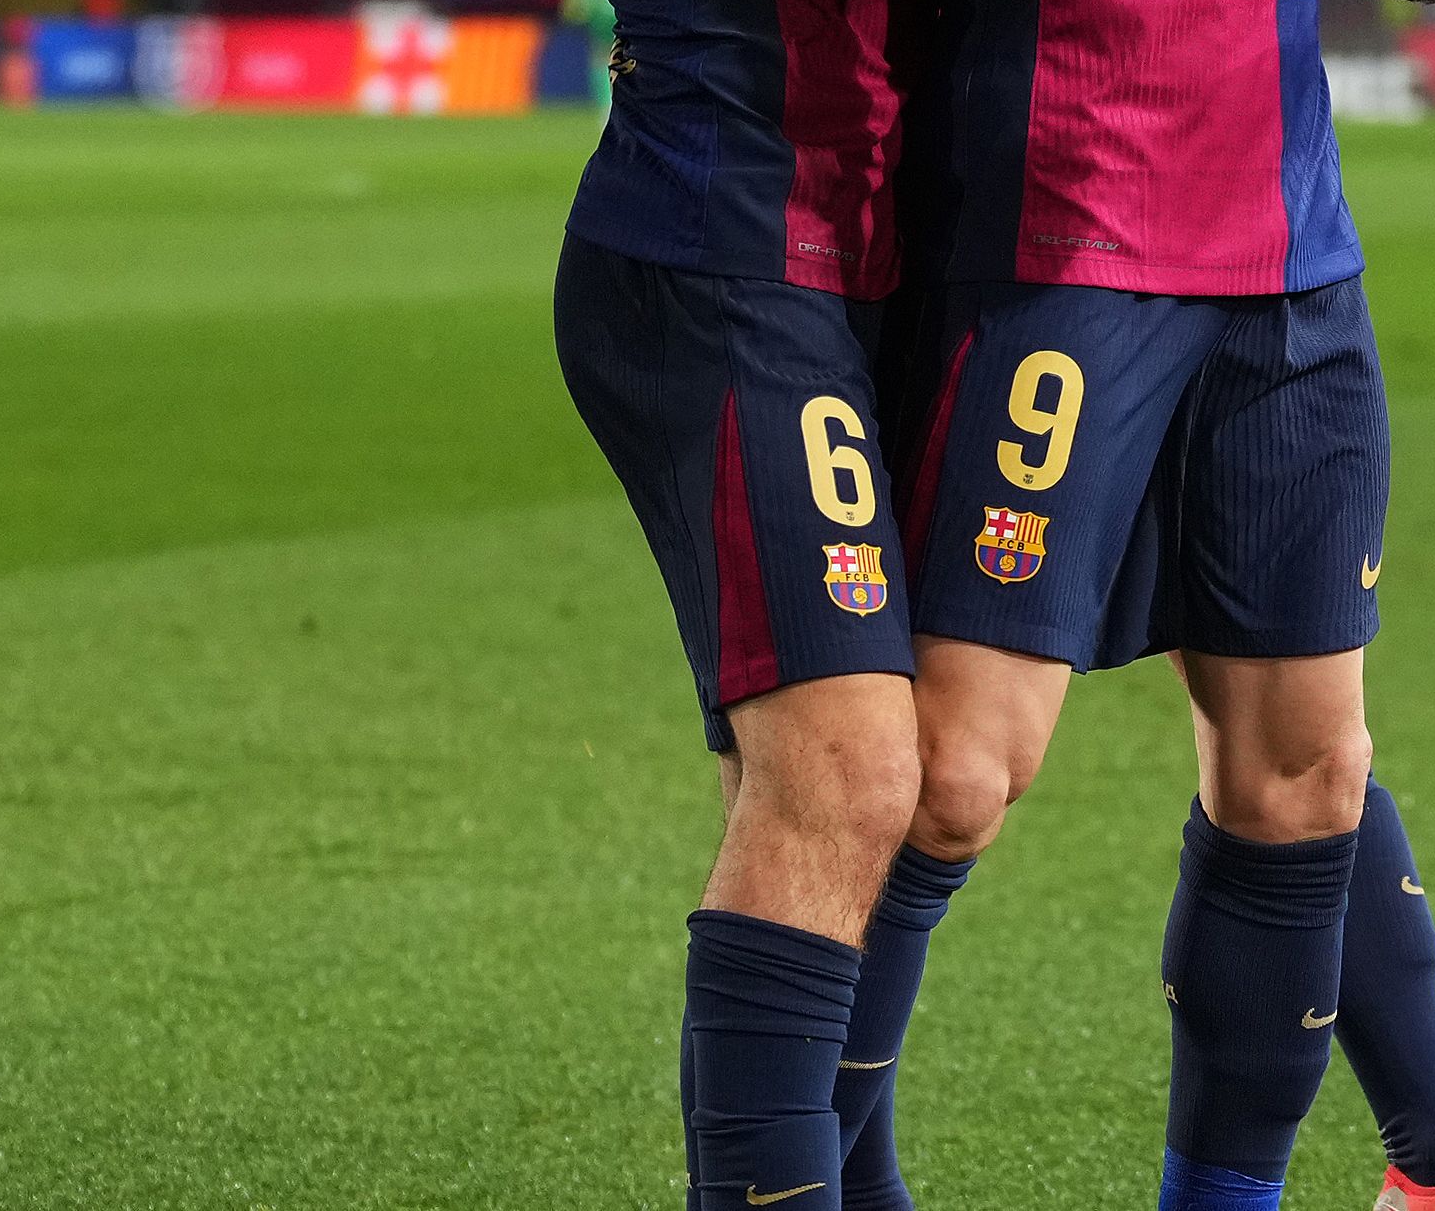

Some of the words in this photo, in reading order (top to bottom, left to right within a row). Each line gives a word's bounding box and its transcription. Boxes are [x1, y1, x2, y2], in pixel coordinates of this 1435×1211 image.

[996, 349, 1085, 491] 9
[801, 395, 876, 527] 6
[845, 573, 870, 583] FCB
[997, 539, 1025, 552] FCB
